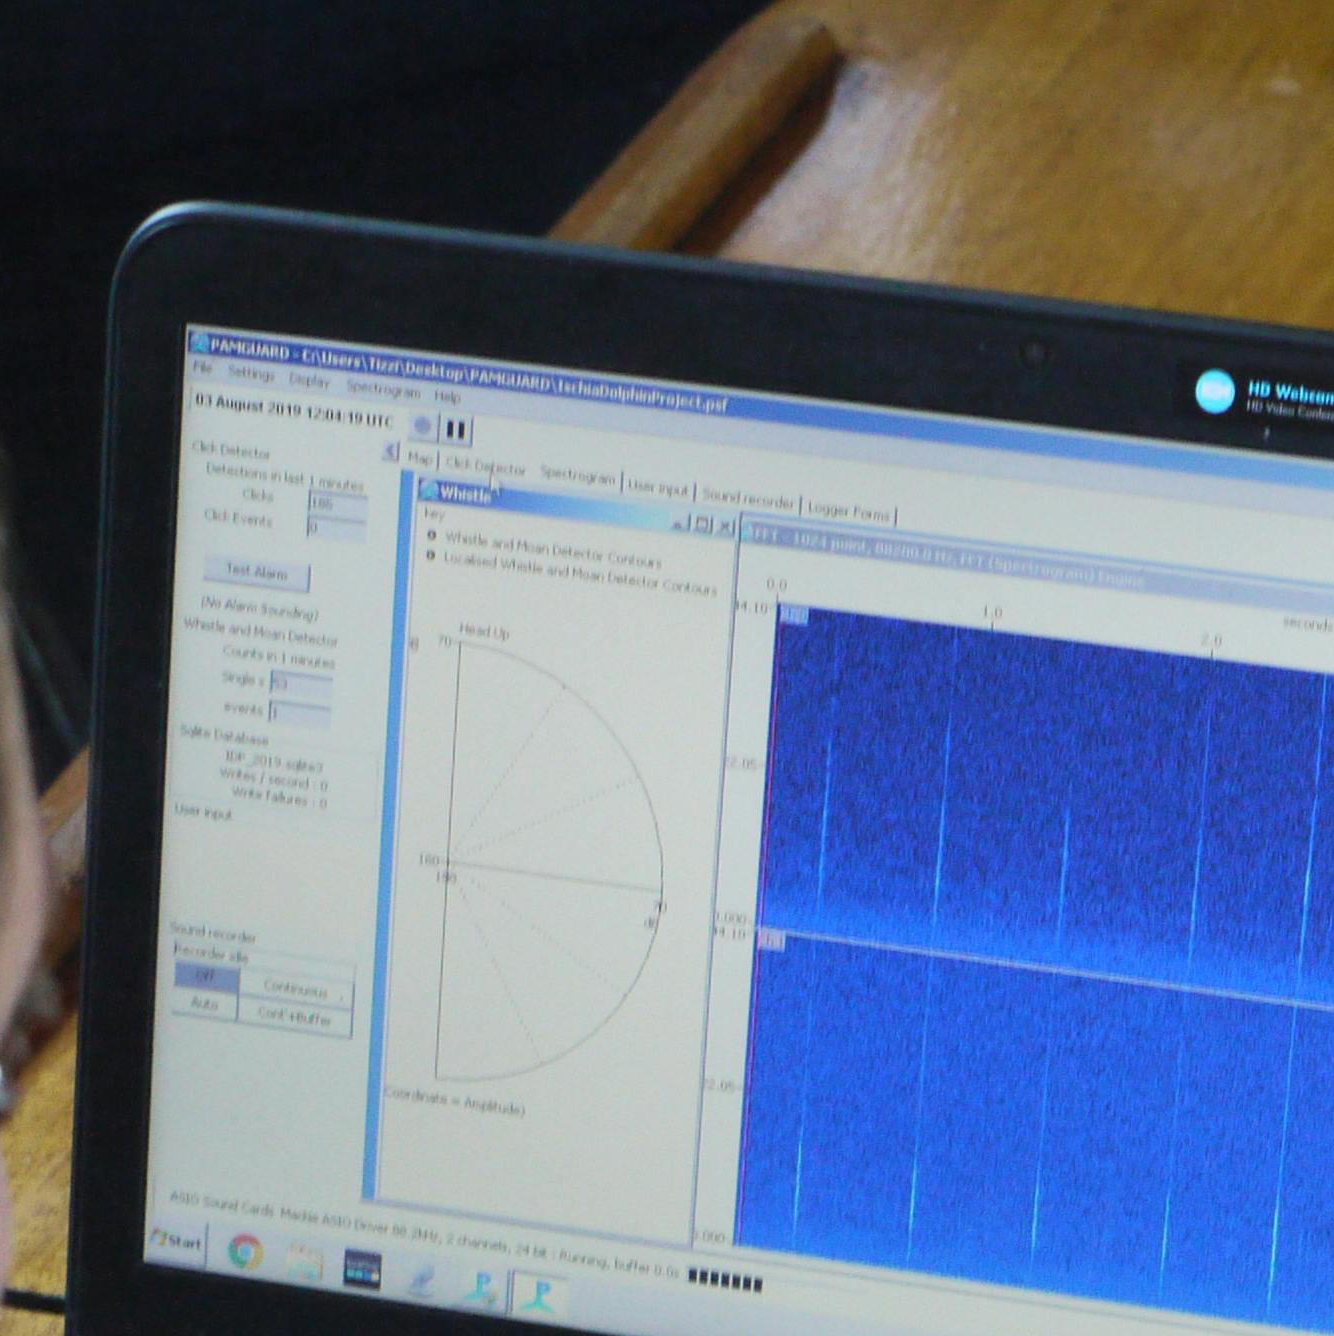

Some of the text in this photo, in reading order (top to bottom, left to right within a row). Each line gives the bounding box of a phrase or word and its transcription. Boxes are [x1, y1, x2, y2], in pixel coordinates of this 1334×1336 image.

[210, 334, 290, 361] PAMGUARD
[193, 361, 462, 406] File Settings Display Spectrogram Help
[1248, 379, 1271, 399] HD
[195, 392, 213, 406] 03
[215, 395, 265, 415] August
[267, 400, 302, 416] 2019
[365, 414, 394, 429] UTC
[1266, 401, 1295, 418] Video
[191, 440, 271, 461] Click Detector
[408, 451, 434, 468] Map
[206, 461, 365, 493] Detections in last minutes
[445, 454, 527, 478] Click Detector
[540, 464, 616, 488] Spectrogram
[242, 487, 275, 503] Clicks
[440, 484, 492, 506] Whistle
[628, 478, 656, 495] User
[703, 485, 795, 511] Sound recorder
[204, 507, 273, 529] Click Events
[807, 500, 890, 522] Logger Forms
[445, 530, 663, 570] Whistle and Moan Detector Contours
[227, 561, 289, 582] Test Alarm
[443, 551, 718, 598] Localised Whistle and Moan Detector Contours
[987, 556, 1096, 587] (Spectrogram)
[1098, 568, 1146, 590] Engine
[766, 577, 788, 592] 0.0
[224, 597, 258, 614] Alarm
[260, 601, 320, 623] Sounding)
[983, 604, 1004, 619] 1.0
[183, 616, 339, 649] Whistle and Moan Detector
[459, 621, 511, 641] Head Up
[1283, 615, 1334, 634] seconds
[1200, 632, 1223, 649] 2.0
[222, 644, 336, 671] Counts in minutes
[223, 701, 265, 718] events
[214, 727, 270, 747] Database
[219, 766, 311, 791] Writes second
[174, 803, 200, 818] User
[170, 921, 257, 945] Sound recorder
[173, 940, 226, 961] Recorder
[195, 967, 217, 983] Off
[264, 978, 329, 1001] Continuous
[190, 995, 220, 1012] Auto
[464, 1095, 526, 1119] Amplitude)
[169, 1235, 202, 1252] Start
[202, 1194, 238, 1213] Sound
[354, 1217, 389, 1234] Driver
[614, 1256, 651, 1276] buffer
